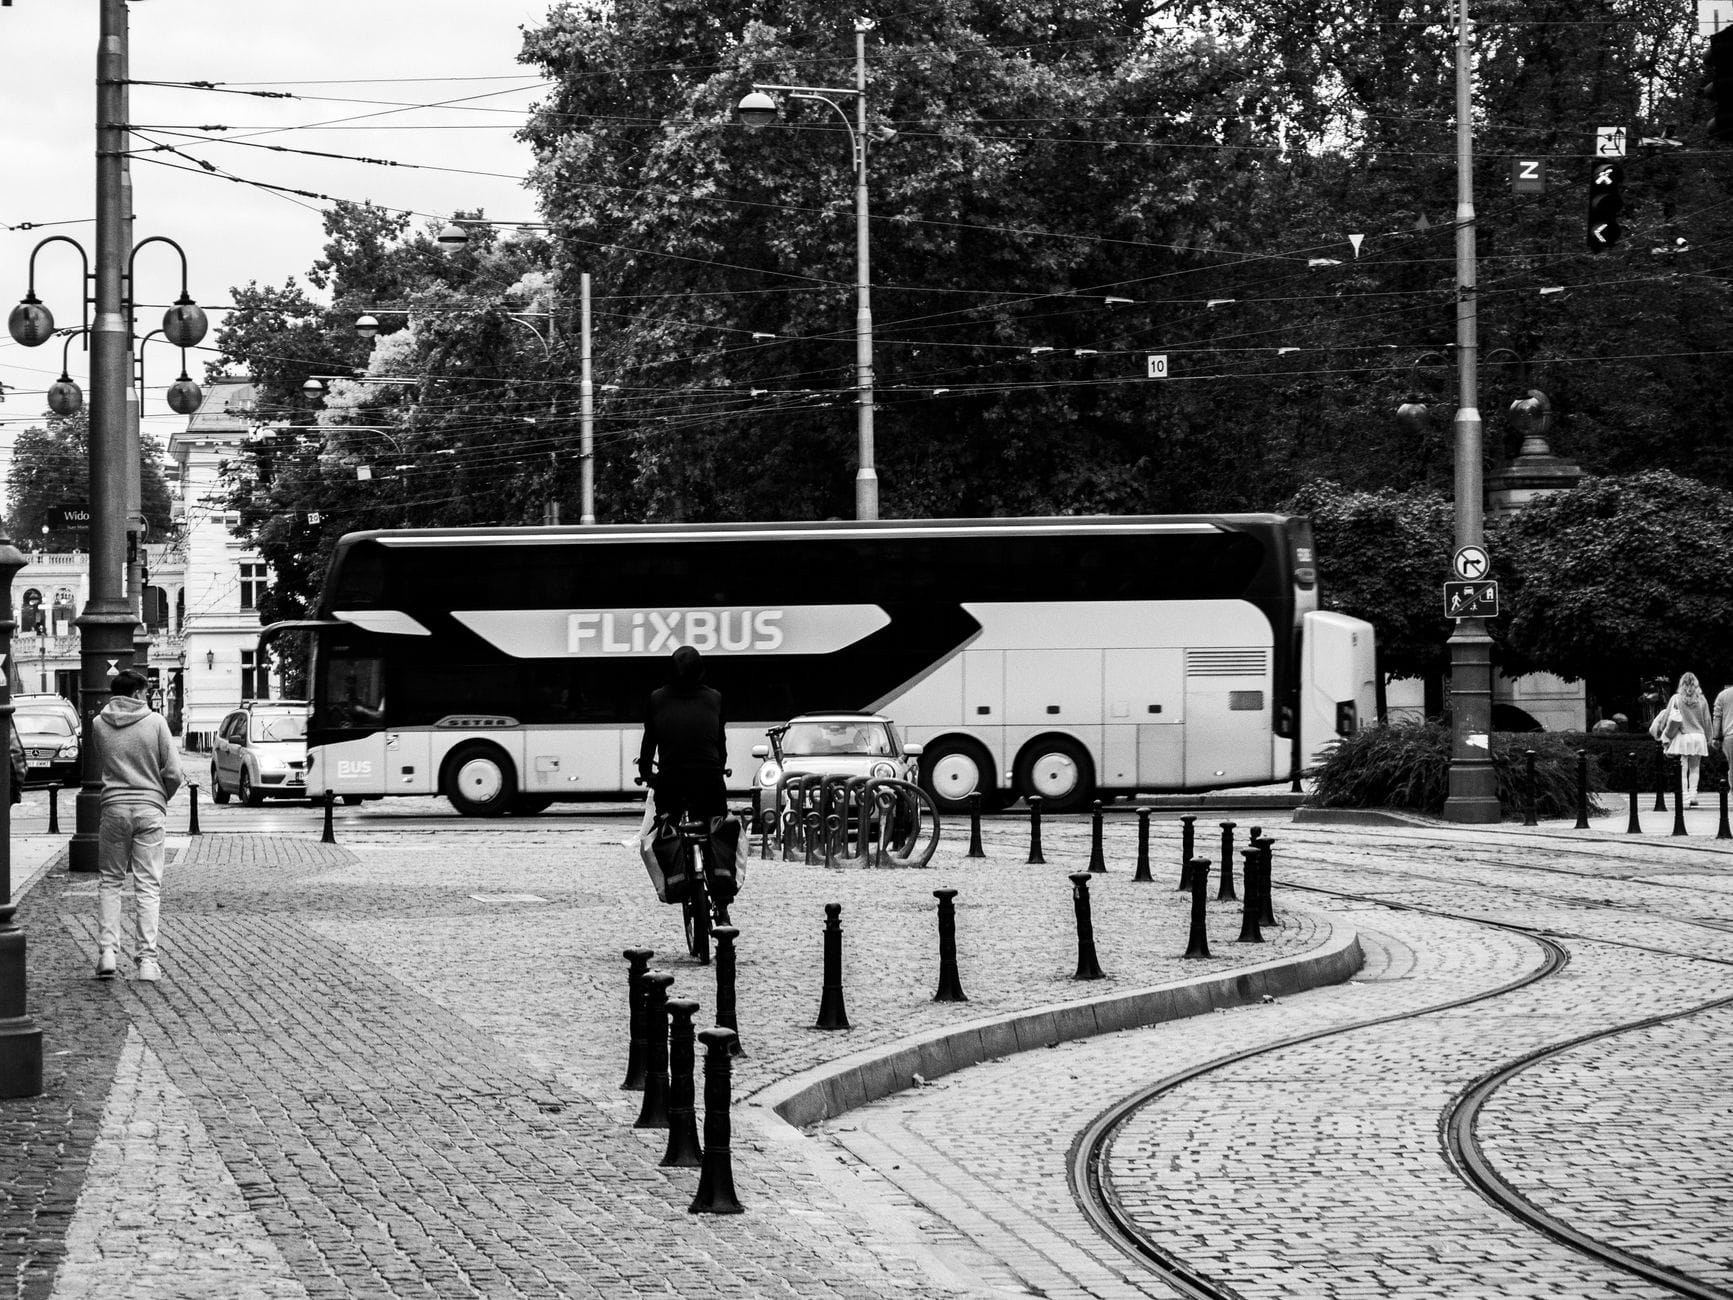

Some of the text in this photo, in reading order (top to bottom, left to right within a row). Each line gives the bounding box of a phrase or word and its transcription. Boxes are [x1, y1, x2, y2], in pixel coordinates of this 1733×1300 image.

[1520, 162, 1539, 178] Z
[1151, 360, 1164, 373] 10
[64, 510, 90, 520] Wido
[338, 760, 372, 774] BUS
